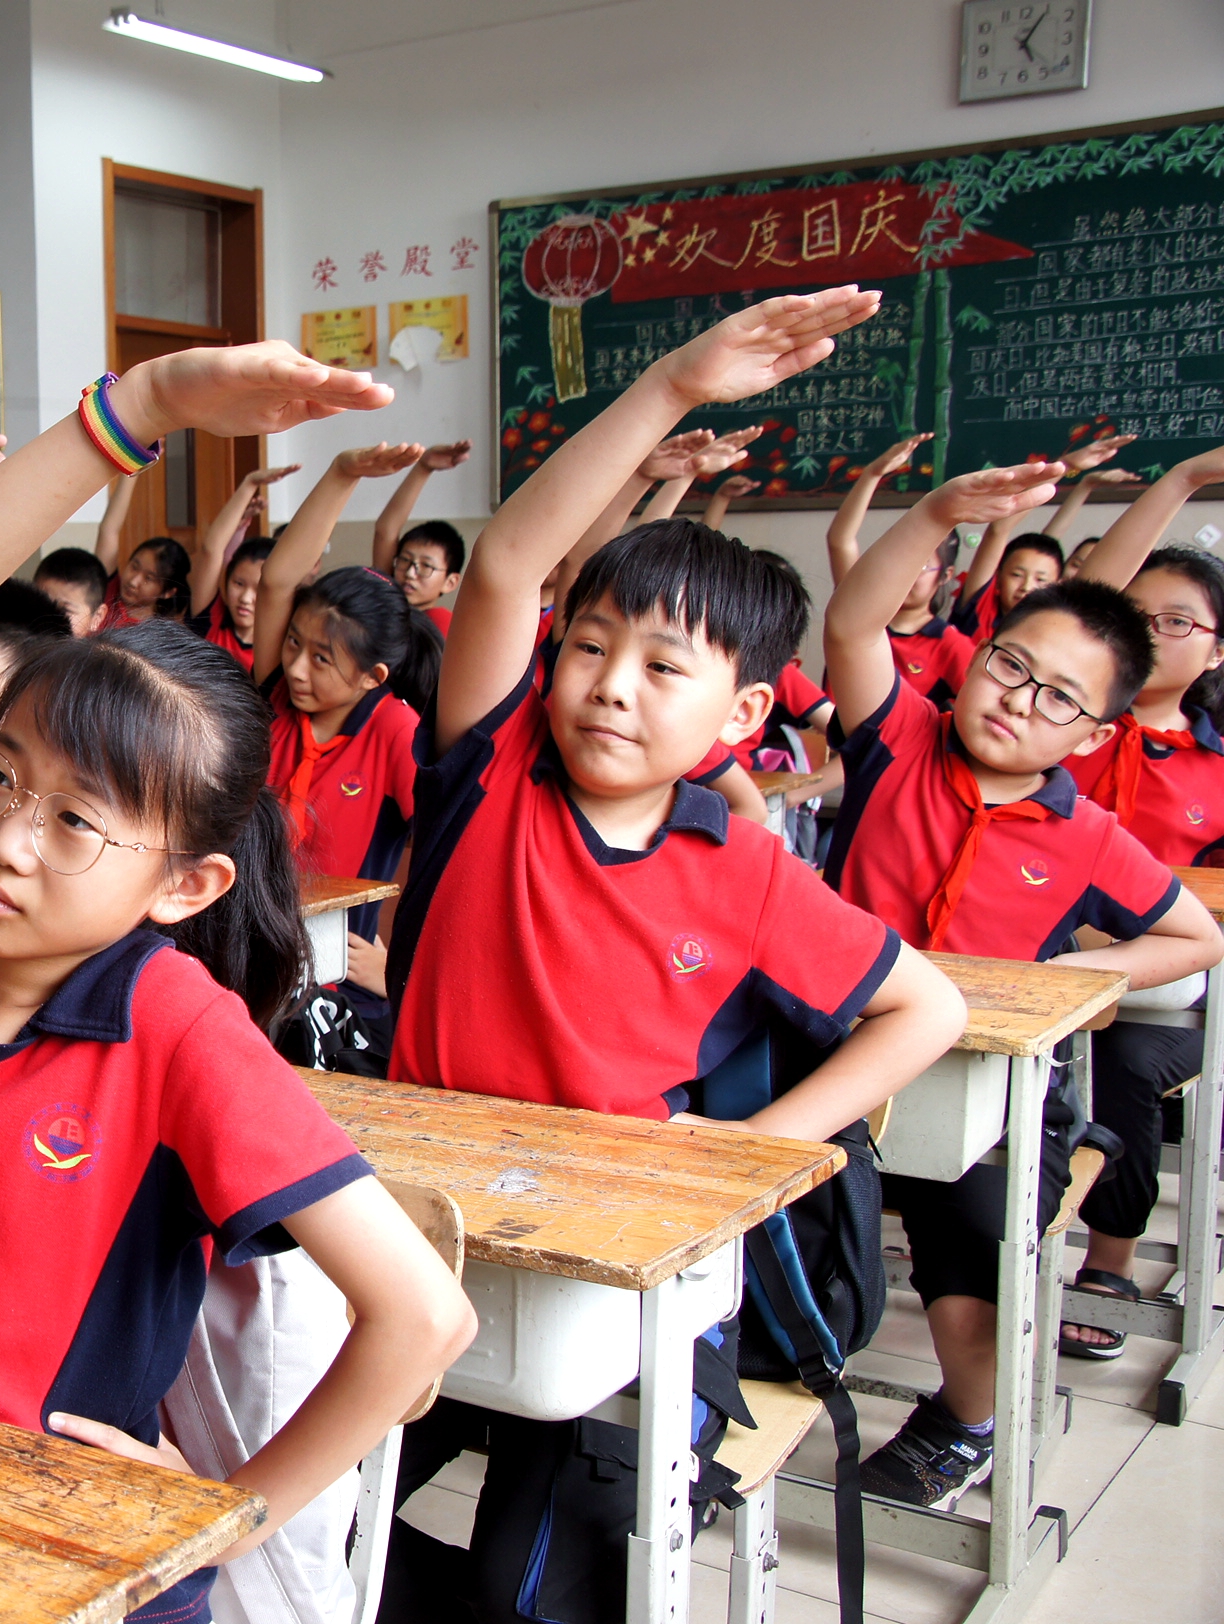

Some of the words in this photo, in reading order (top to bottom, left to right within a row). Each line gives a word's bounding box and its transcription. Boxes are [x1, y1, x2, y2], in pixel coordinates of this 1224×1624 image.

[1064, 8, 1074, 22] 2
[1061, 31, 1072, 45] 3
[998, 72, 1008, 86] 7
[1017, 70, 1029, 83] 6
[669, 190, 918, 272] 欢度国庆
[312, 237, 479, 292] 荣誉殿堂
